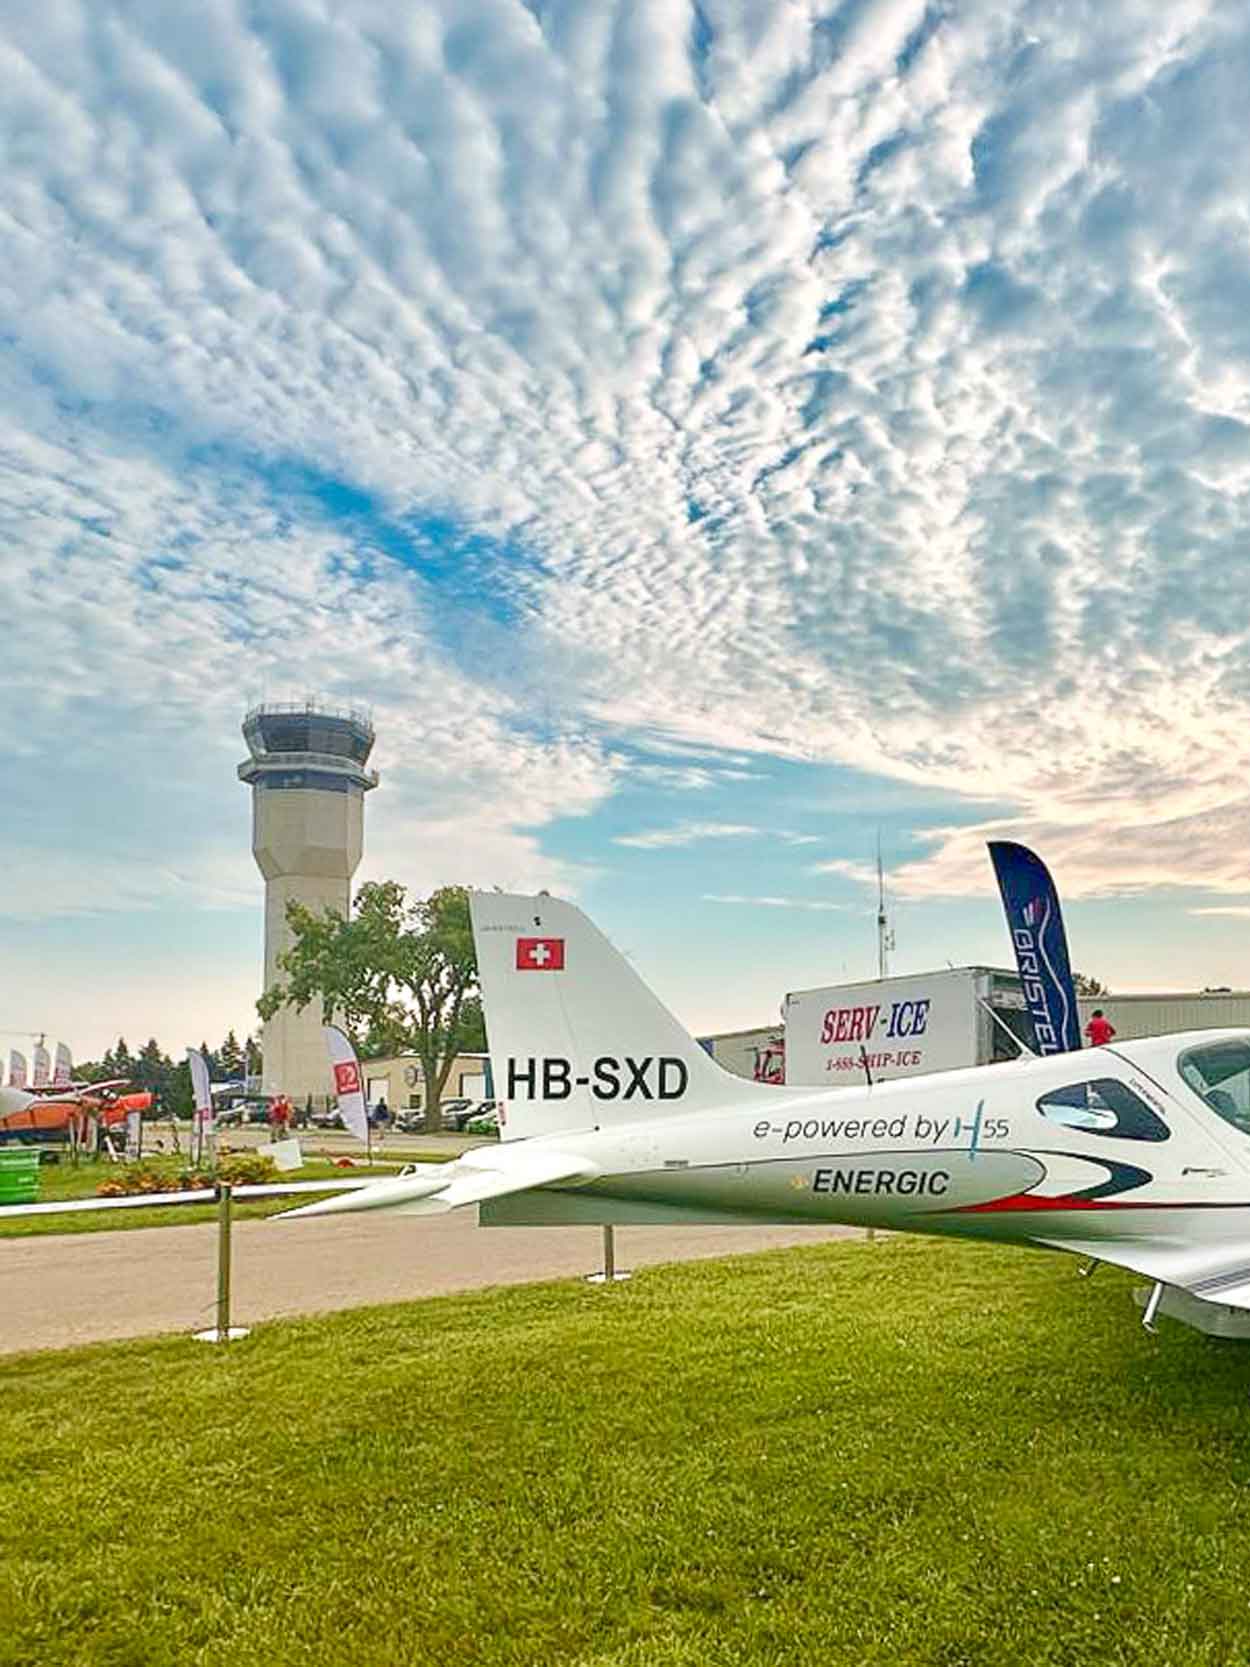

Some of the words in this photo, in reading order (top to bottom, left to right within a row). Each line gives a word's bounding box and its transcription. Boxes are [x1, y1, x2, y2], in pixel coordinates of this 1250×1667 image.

[507, 1056, 689, 1101] HB-SXD
[753, 1114, 908, 1144] e-powered
[914, 1114, 950, 1144] by
[812, 1169, 950, 1196] ENERGIC
